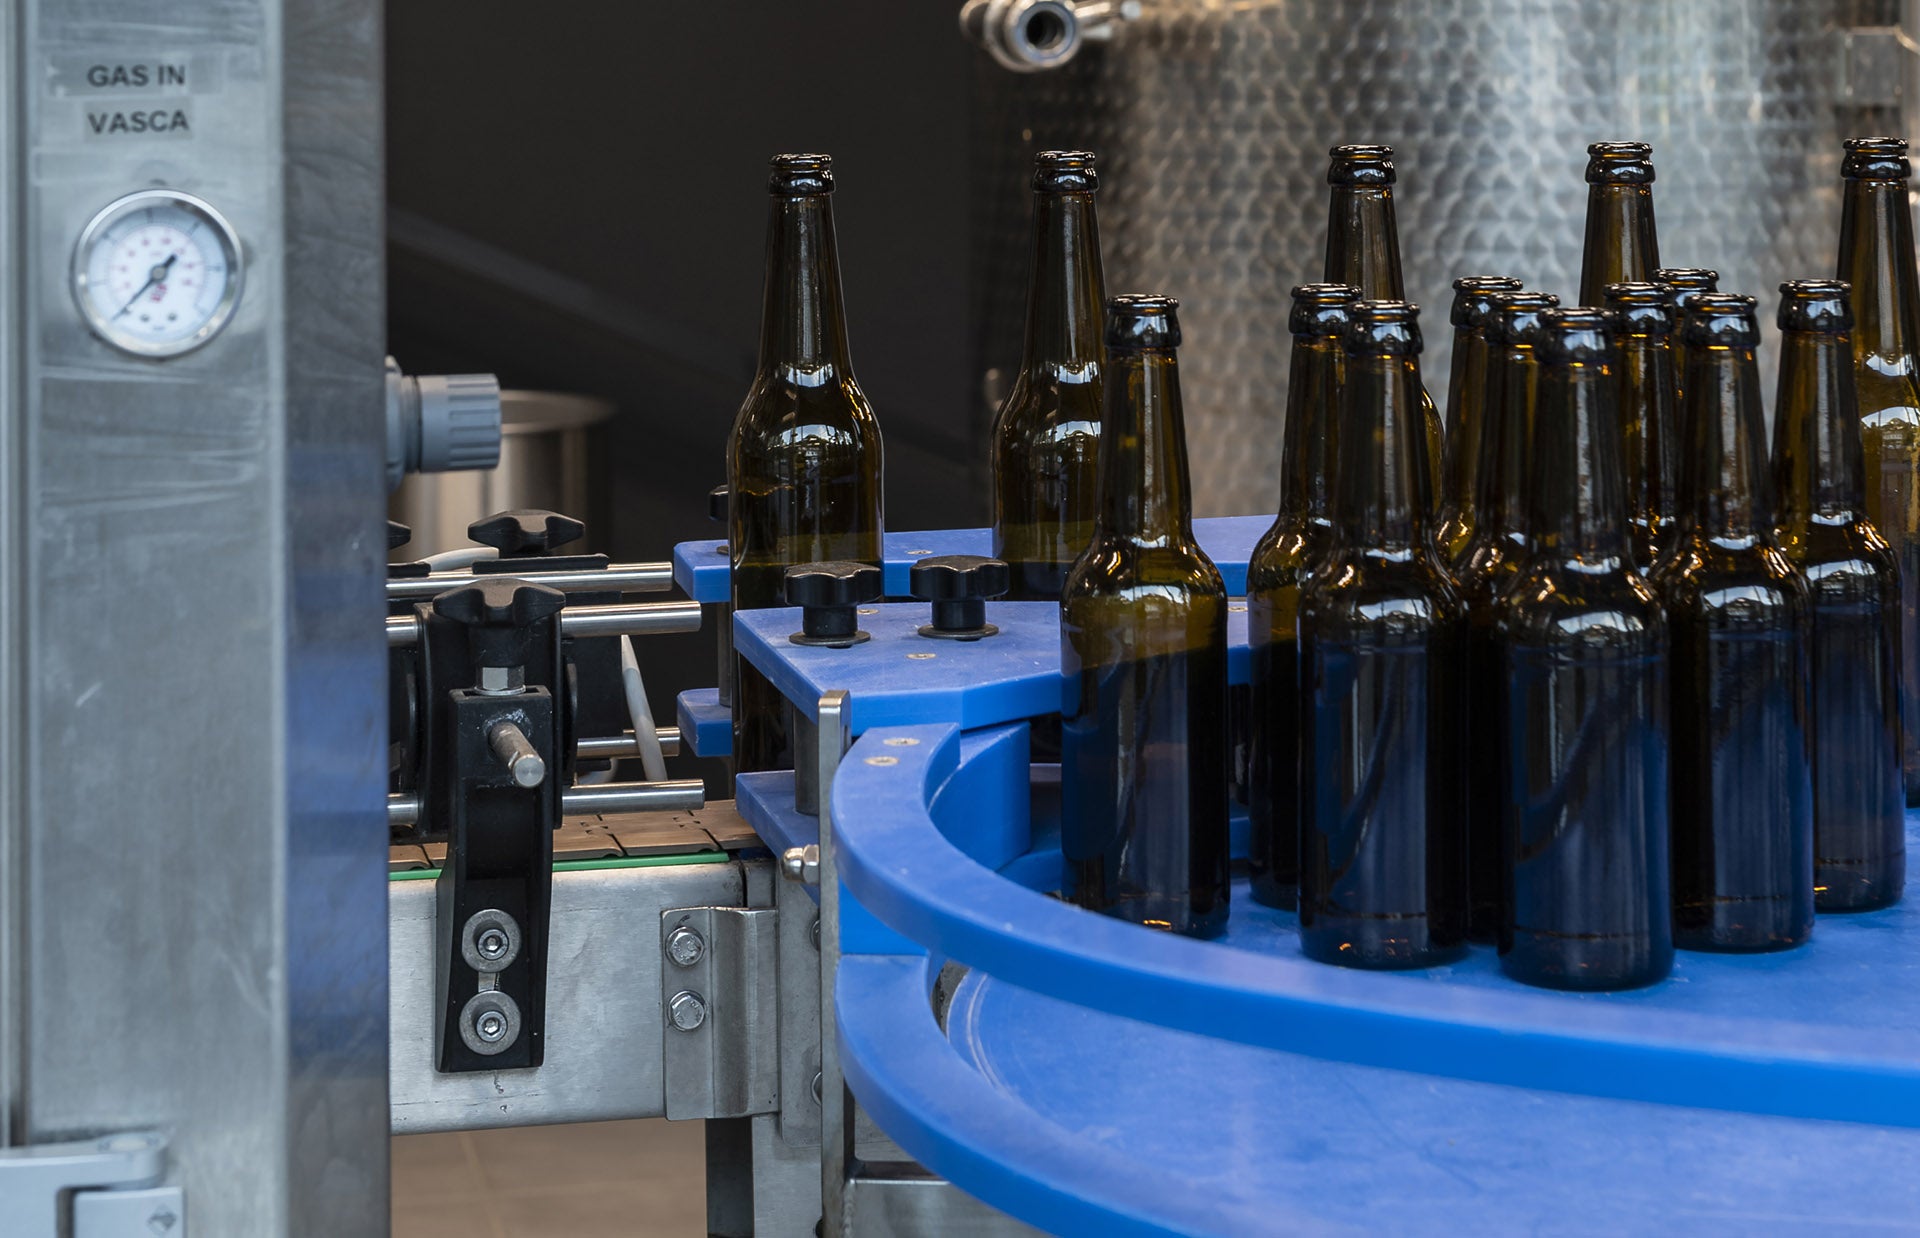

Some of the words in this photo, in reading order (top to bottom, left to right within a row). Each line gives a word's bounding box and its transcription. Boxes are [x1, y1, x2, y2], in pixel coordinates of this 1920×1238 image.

[87, 64, 149, 87] GAS
[157, 65, 186, 86] IN
[87, 110, 190, 134] VASCA
